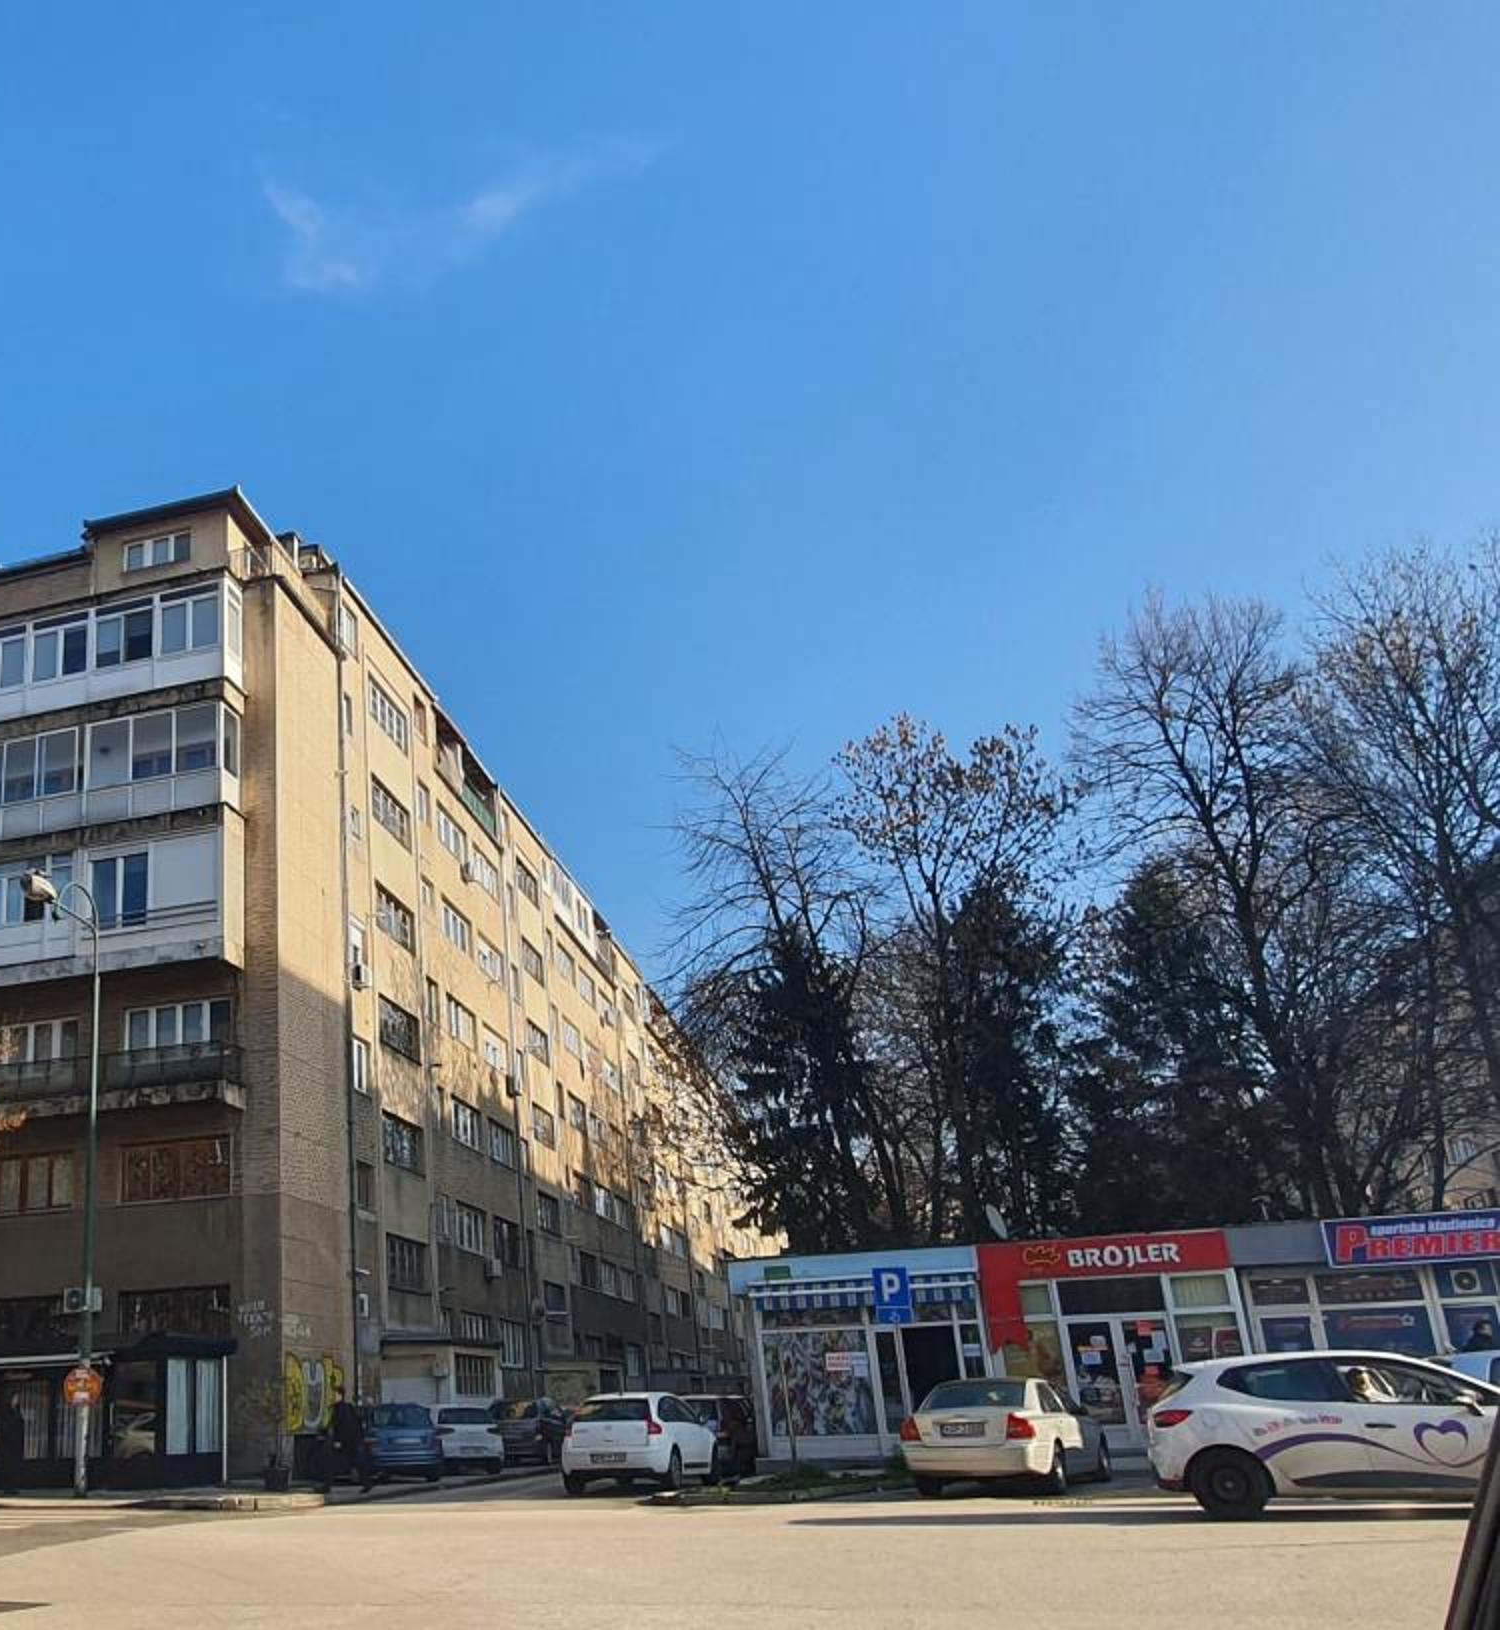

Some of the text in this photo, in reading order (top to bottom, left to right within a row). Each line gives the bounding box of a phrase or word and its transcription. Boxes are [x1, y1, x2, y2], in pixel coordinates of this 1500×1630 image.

[1067, 1243, 1181, 1268] BROJLER
[1336, 1225, 1500, 1262] PREMIER
[881, 1272, 901, 1302] P
